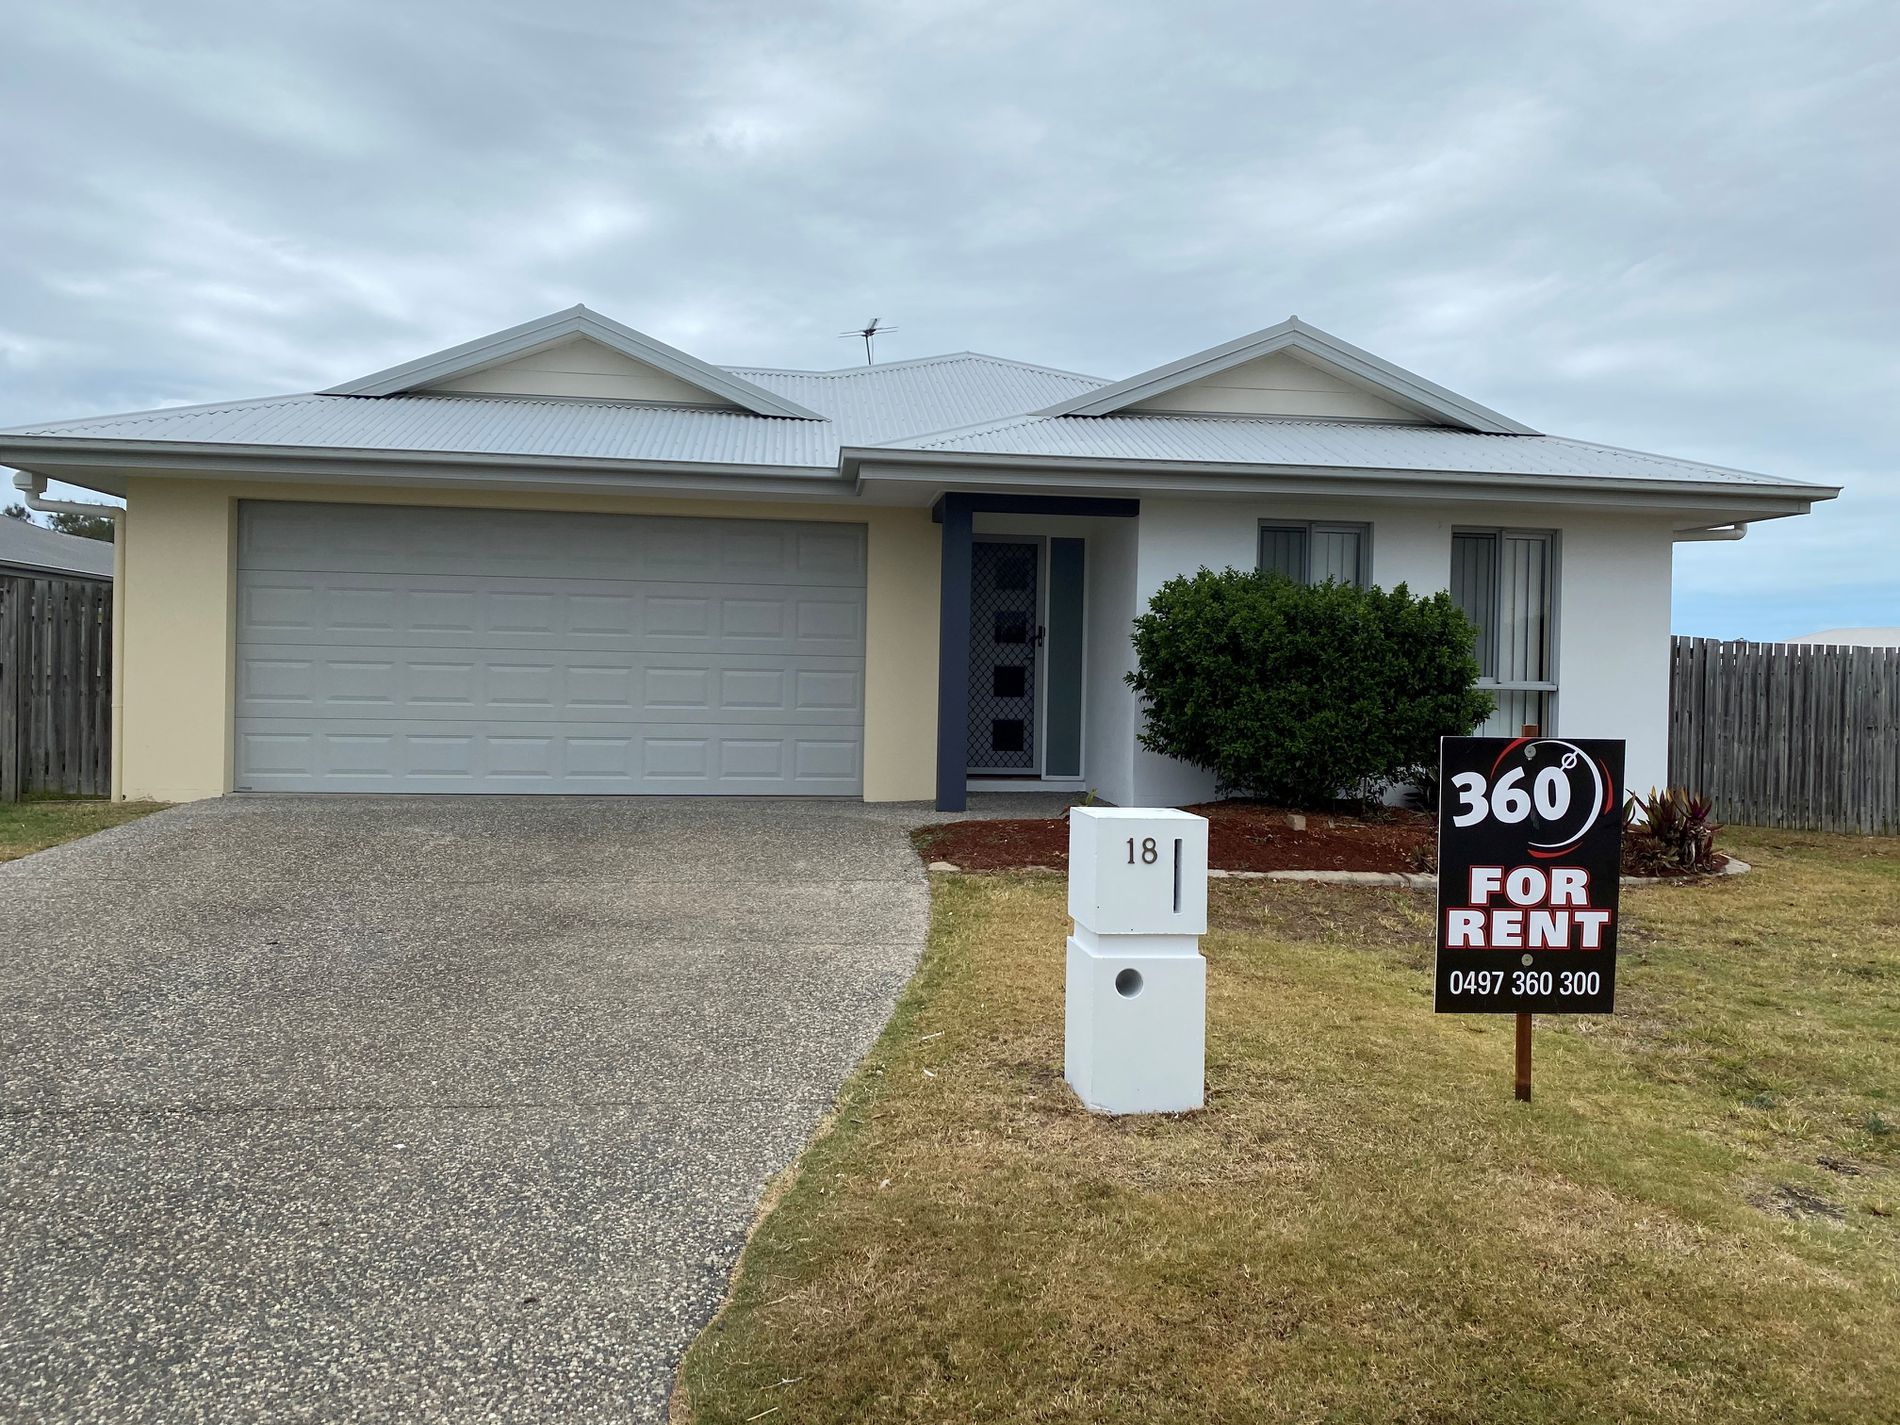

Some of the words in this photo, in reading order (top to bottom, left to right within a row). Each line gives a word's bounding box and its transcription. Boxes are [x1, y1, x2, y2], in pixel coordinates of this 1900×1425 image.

[1127, 837, 1158, 864] 18
[1469, 865, 1590, 907] FOR
[1446, 907, 1612, 949] RENT
[1449, 970, 1504, 996] 0497
[1511, 971, 1552, 996] 360
[1559, 971, 1600, 996] 300
